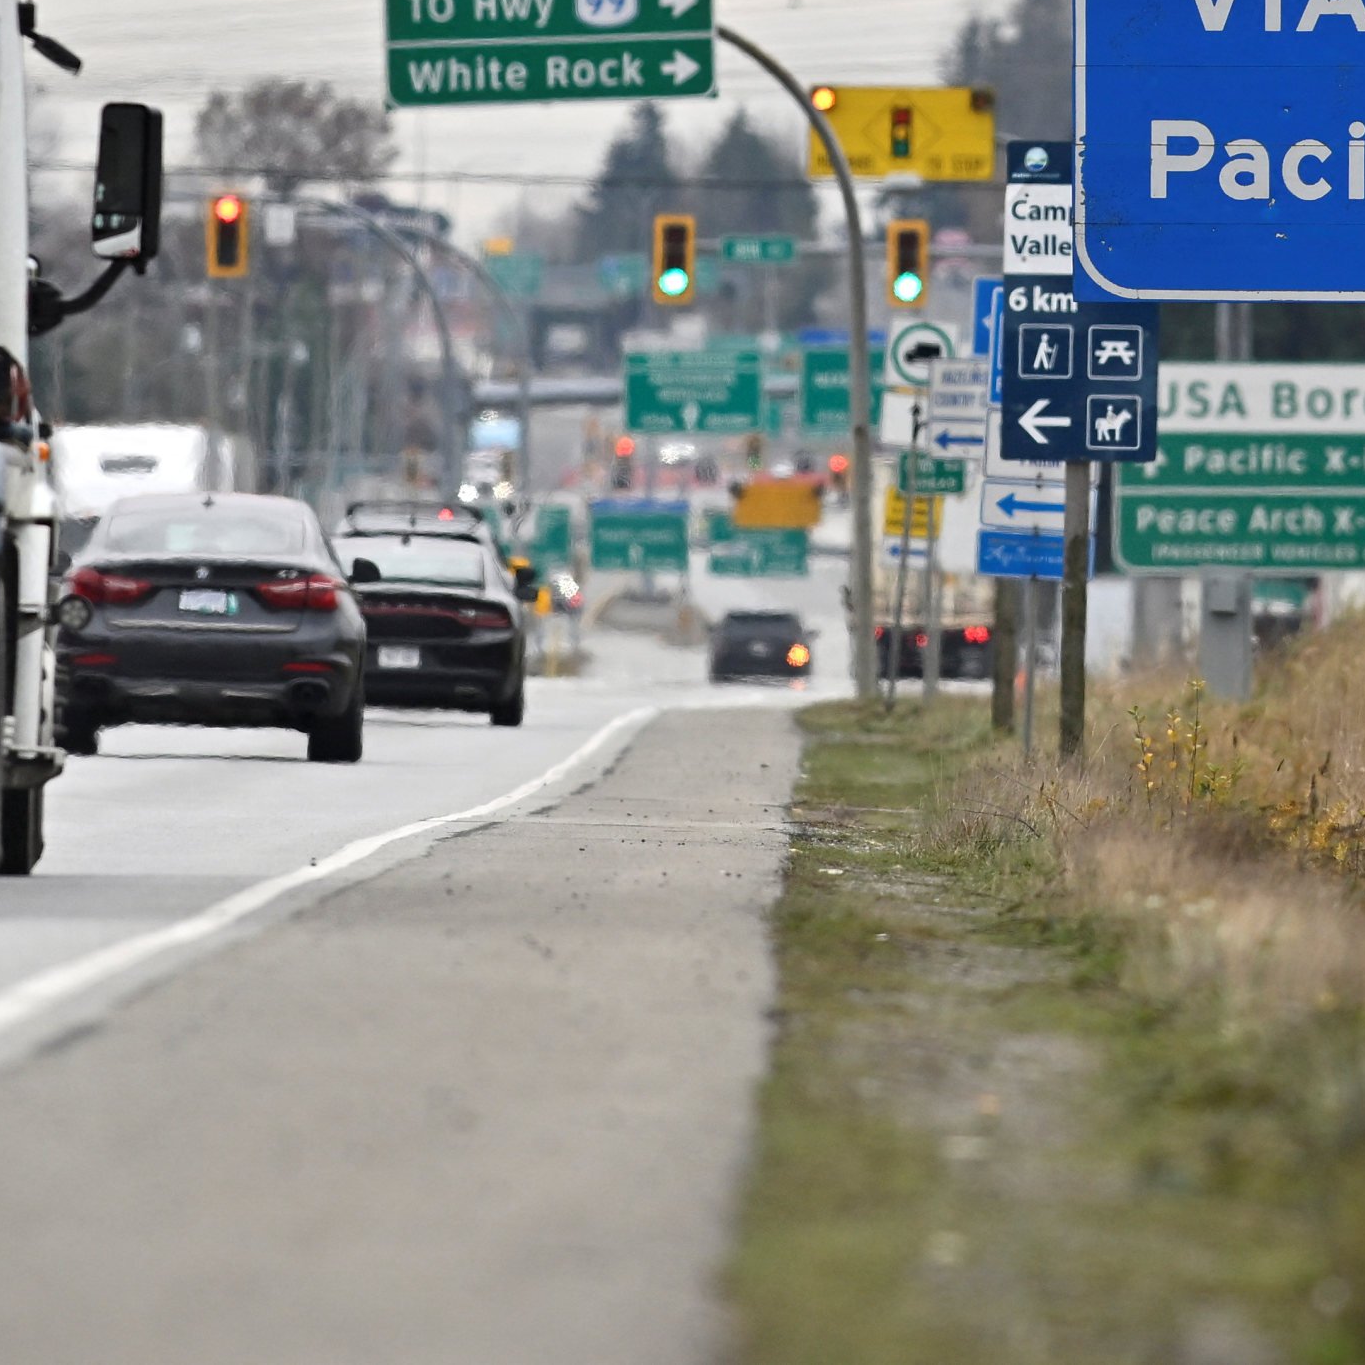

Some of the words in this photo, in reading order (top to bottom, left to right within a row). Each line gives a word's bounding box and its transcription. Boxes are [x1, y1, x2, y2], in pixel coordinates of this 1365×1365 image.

[408, 54, 529, 94] White
[546, 51, 646, 89] Rock
[1010, 233, 1072, 256] Valle
[1008, 286, 1029, 313] 6
[1032, 285, 1078, 313] km
[1184, 444, 1307, 475] Pacific
[1137, 504, 1238, 534] Peace
[1249, 503, 1326, 535] Arch
